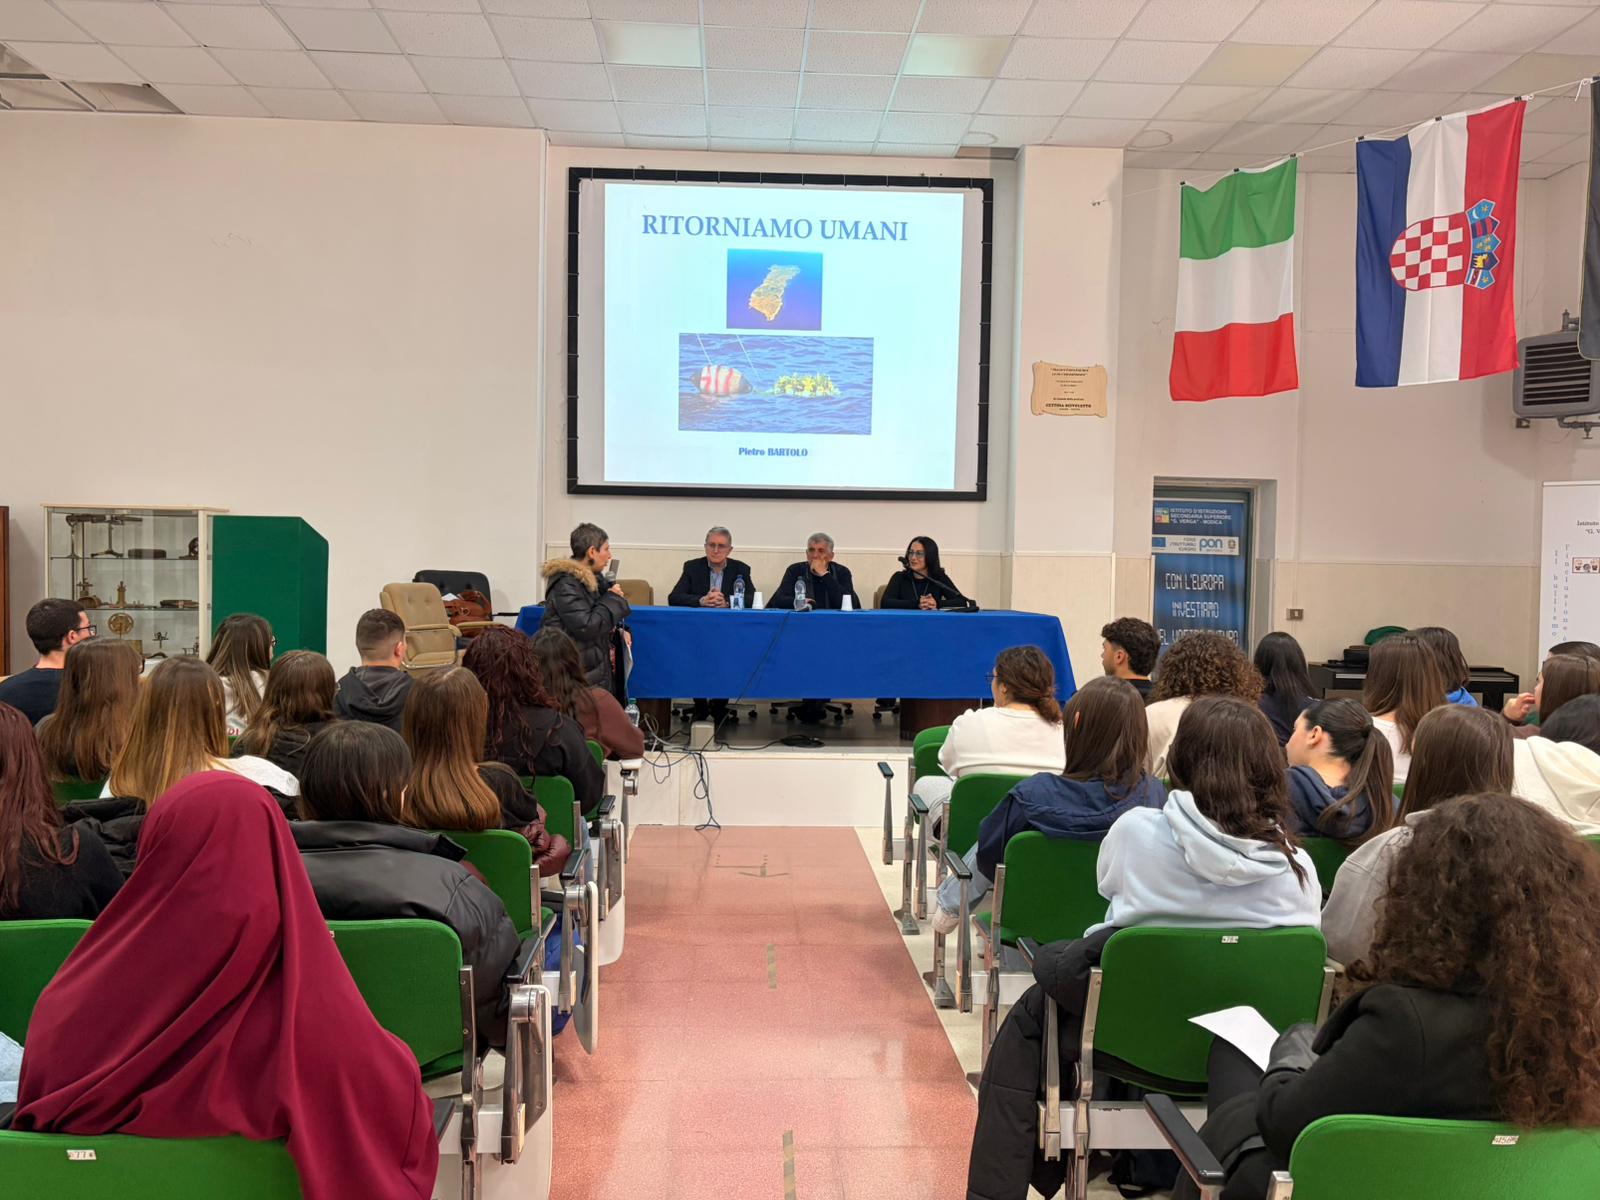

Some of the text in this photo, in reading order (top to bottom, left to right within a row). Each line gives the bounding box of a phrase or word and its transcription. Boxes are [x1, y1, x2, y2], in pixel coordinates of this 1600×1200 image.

[641, 214, 909, 242] RITORNIAMO UMANI
[738, 447, 809, 457] Pietro BARTOLO
[1199, 538, 1223, 551] pon
[1165, 573, 1225, 591] CON L'EUROPA
[1172, 601, 1220, 619] INVESTIAMO
